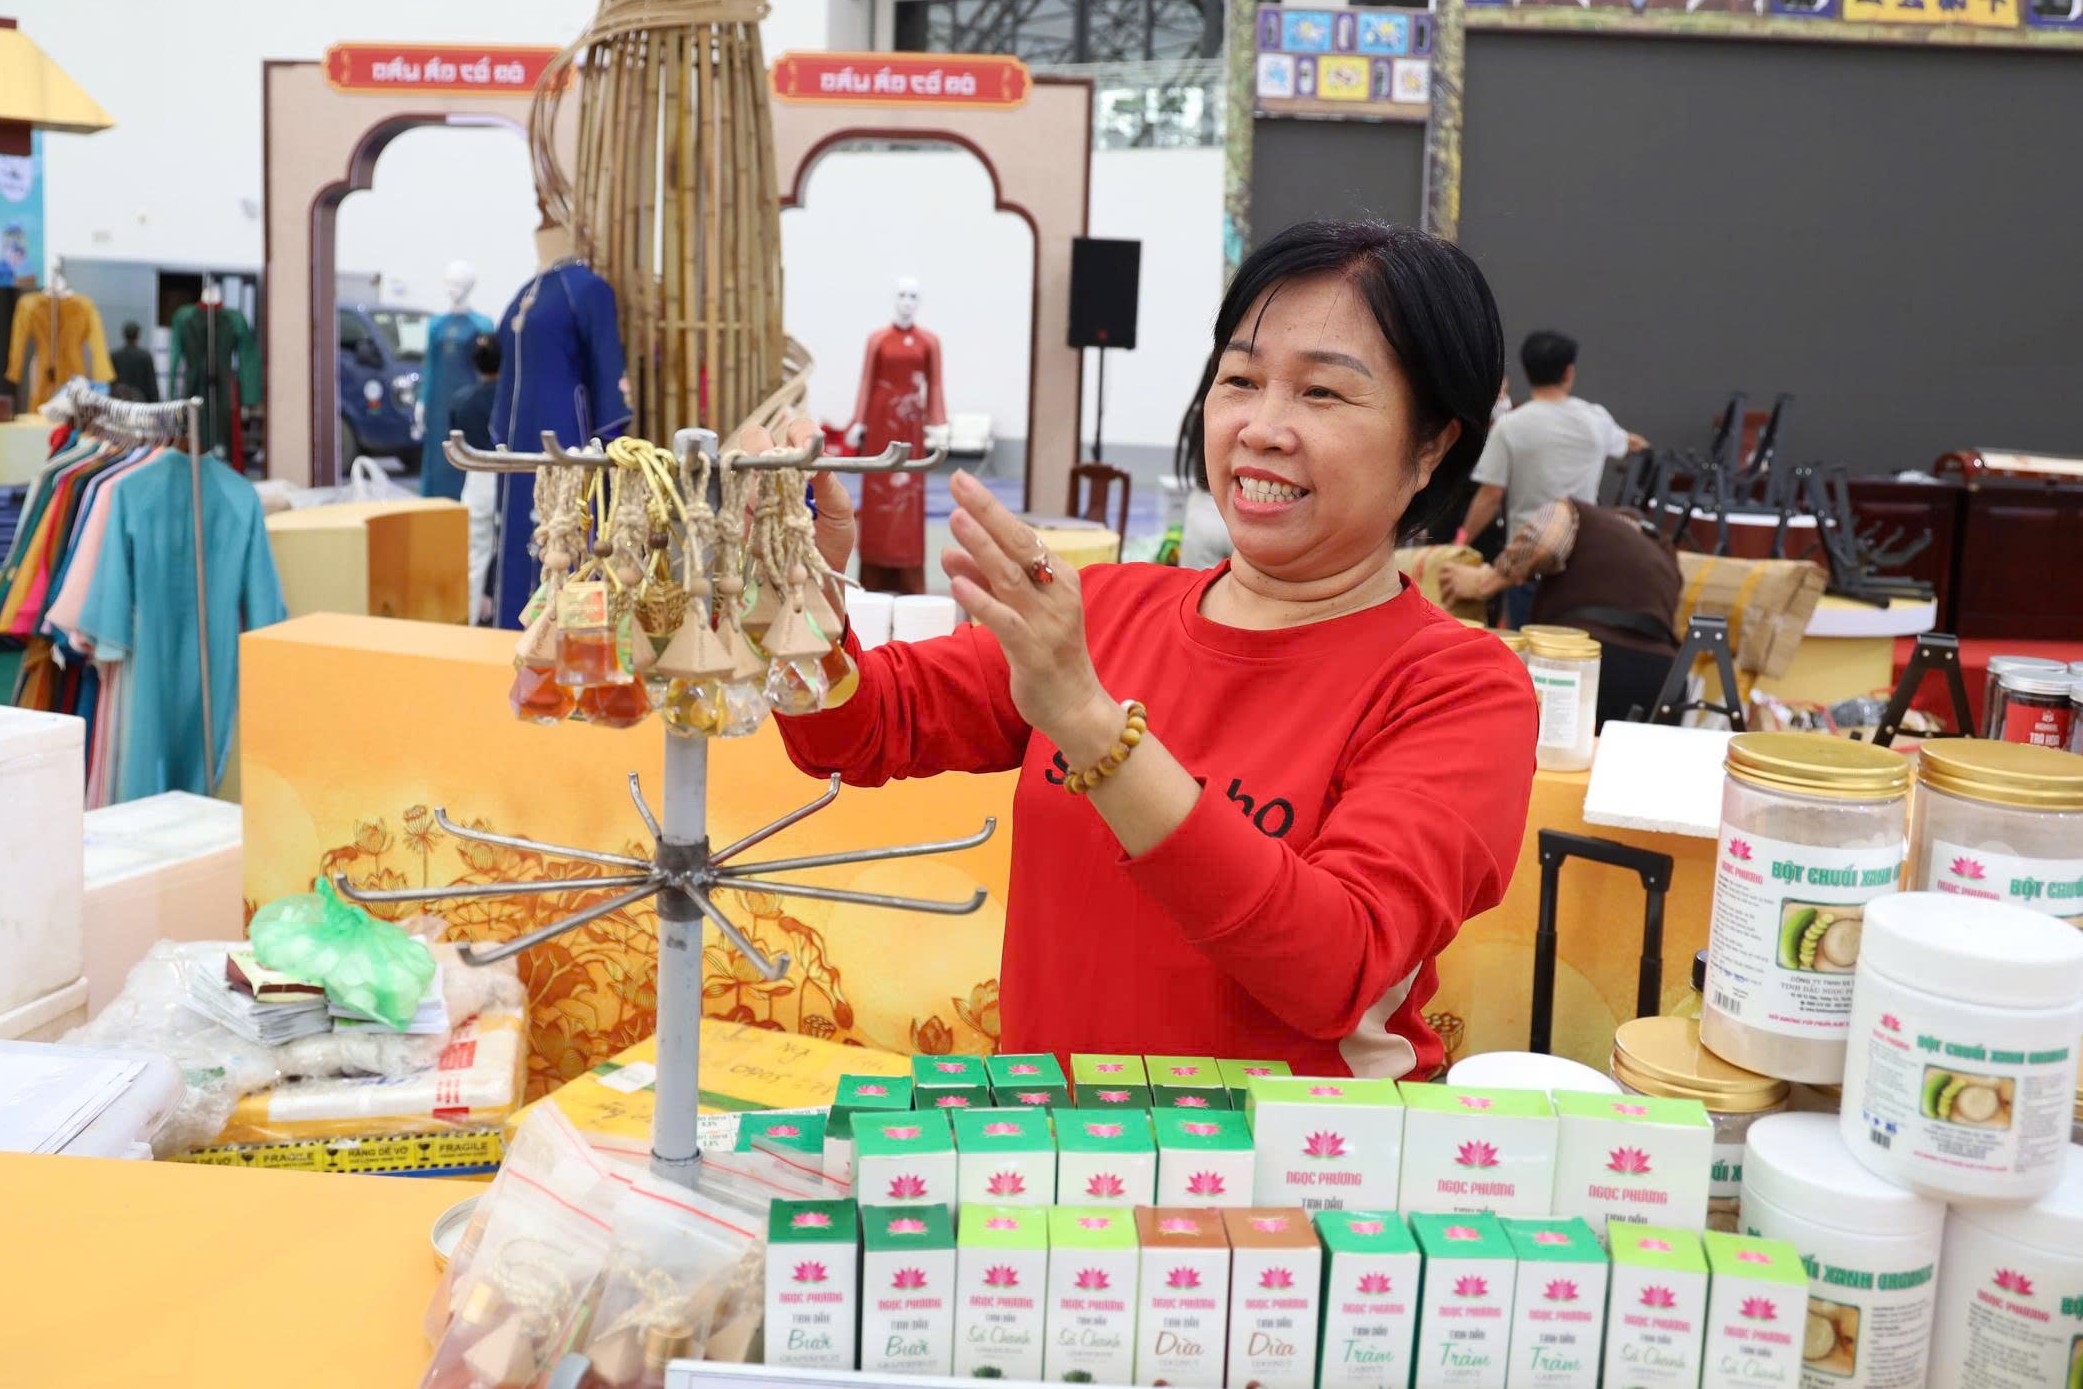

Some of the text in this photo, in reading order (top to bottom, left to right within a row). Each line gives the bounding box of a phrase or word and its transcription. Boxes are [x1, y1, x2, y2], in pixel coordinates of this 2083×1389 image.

[1772, 860, 1804, 884] BỘT
[1808, 863, 1858, 886] CHUỐI
[1860, 867, 1892, 886] XANH
[2010, 876, 2044, 900] BỘT
[263, 1152, 314, 1163] FRAGILE
[439, 1142, 488, 1152] FRAGILE
[1286, 1171, 1362, 1186] NGỌC PHƯƠNG
[1437, 1179, 1515, 1197] NGỌC PHƯƠNG
[1589, 1185, 1668, 1205] NGỌC PHƯƠNG
[1823, 1265, 1874, 1289] XANH
[1155, 1331, 1205, 1356] Dừa
[1248, 1332, 1296, 1356] Dừa
[1343, 1339, 1394, 1363] Tràm
[1440, 1343, 1491, 1367] Tràm
[1530, 1346, 1582, 1371] Tràm
